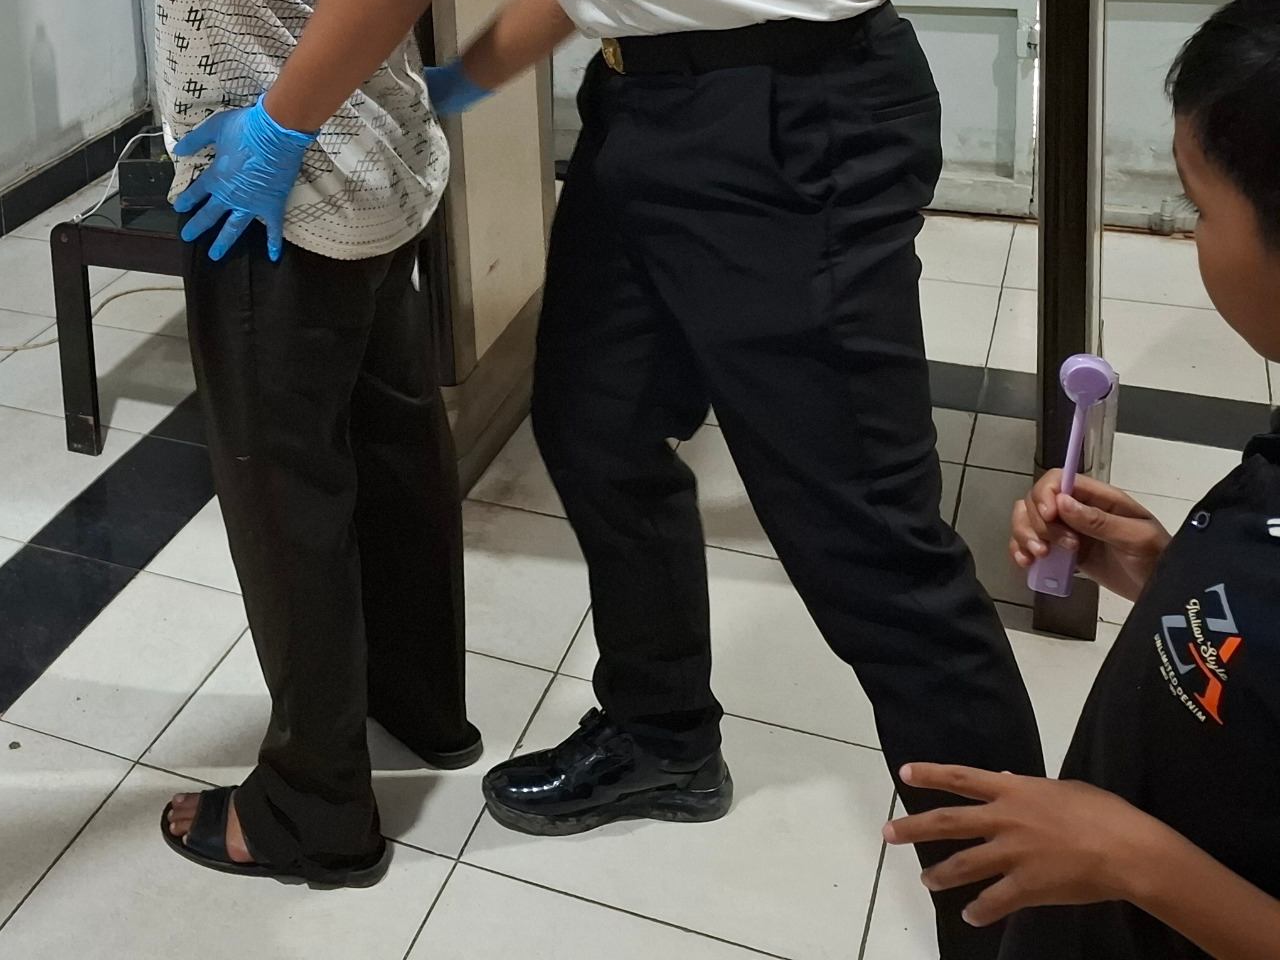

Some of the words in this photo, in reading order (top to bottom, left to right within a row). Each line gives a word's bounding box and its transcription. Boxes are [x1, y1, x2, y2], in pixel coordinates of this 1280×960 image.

[1185, 599, 1206, 644] Italian
[1201, 642, 1229, 681] Style
[1177, 686, 1206, 722] DENIM
